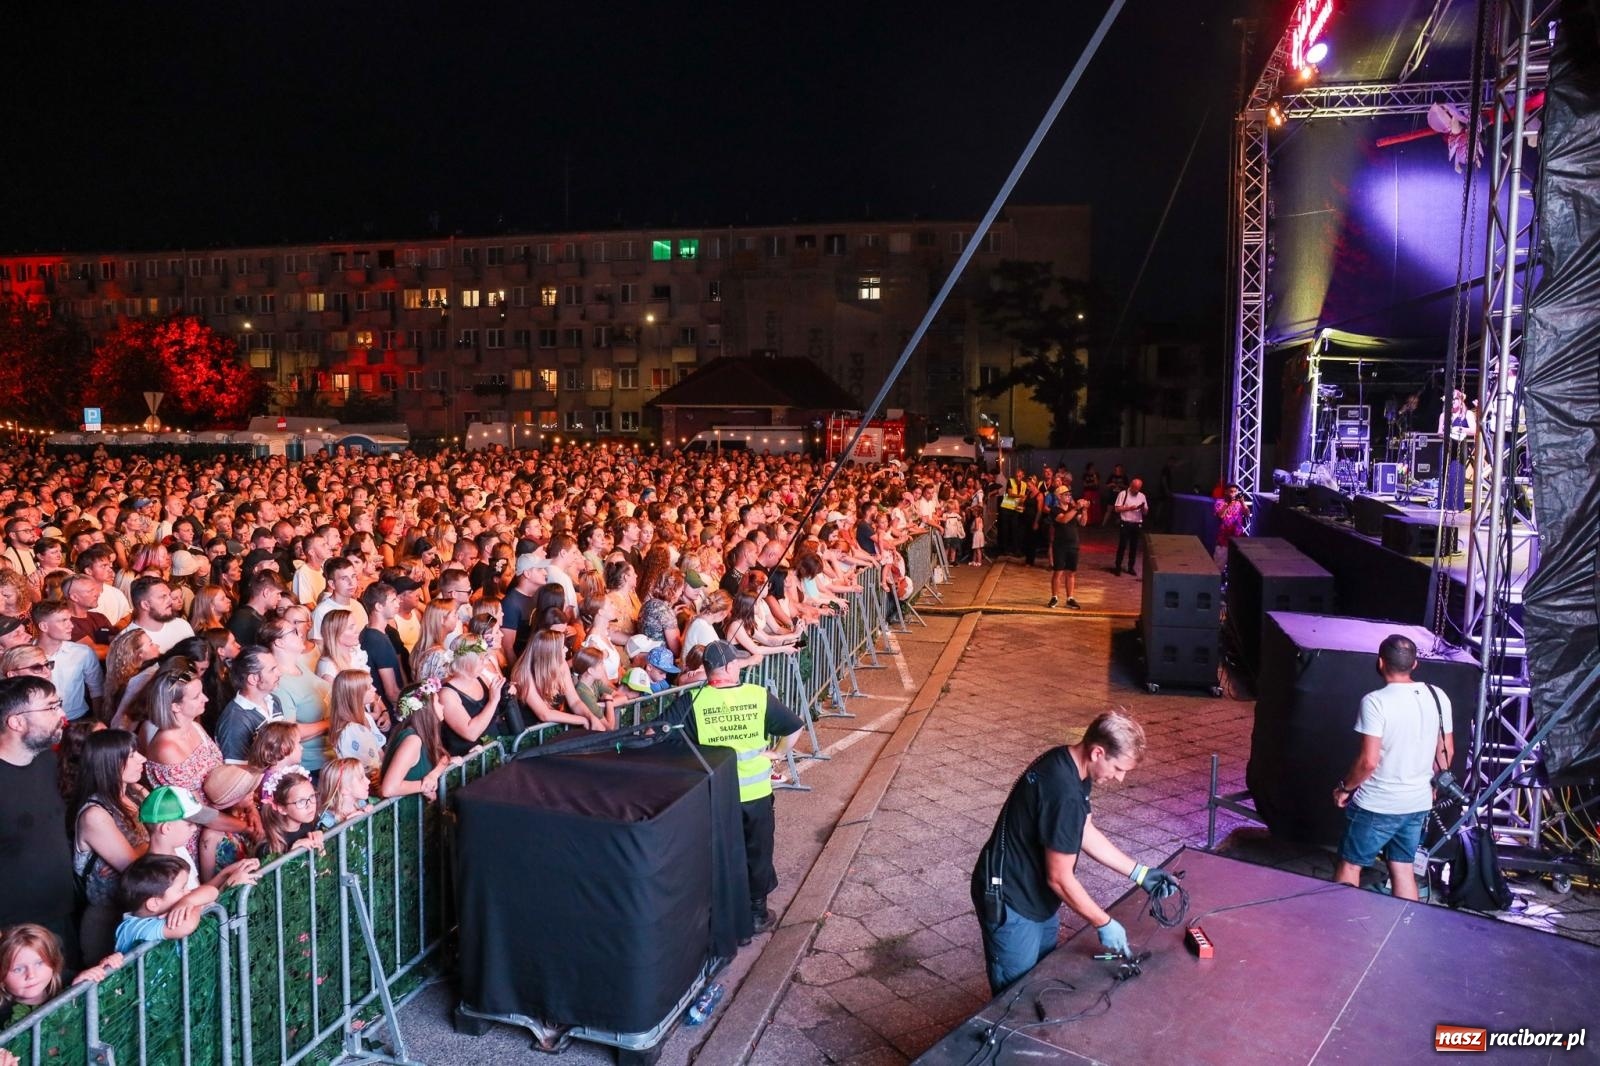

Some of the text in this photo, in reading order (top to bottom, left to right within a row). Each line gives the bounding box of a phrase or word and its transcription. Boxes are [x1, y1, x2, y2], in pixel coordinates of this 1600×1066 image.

[88, 410, 97, 422] P
[730, 704, 757, 712] SYSTEM
[704, 713, 758, 724] SECURITY
[708, 732, 759, 743] INFORMACYJNA
